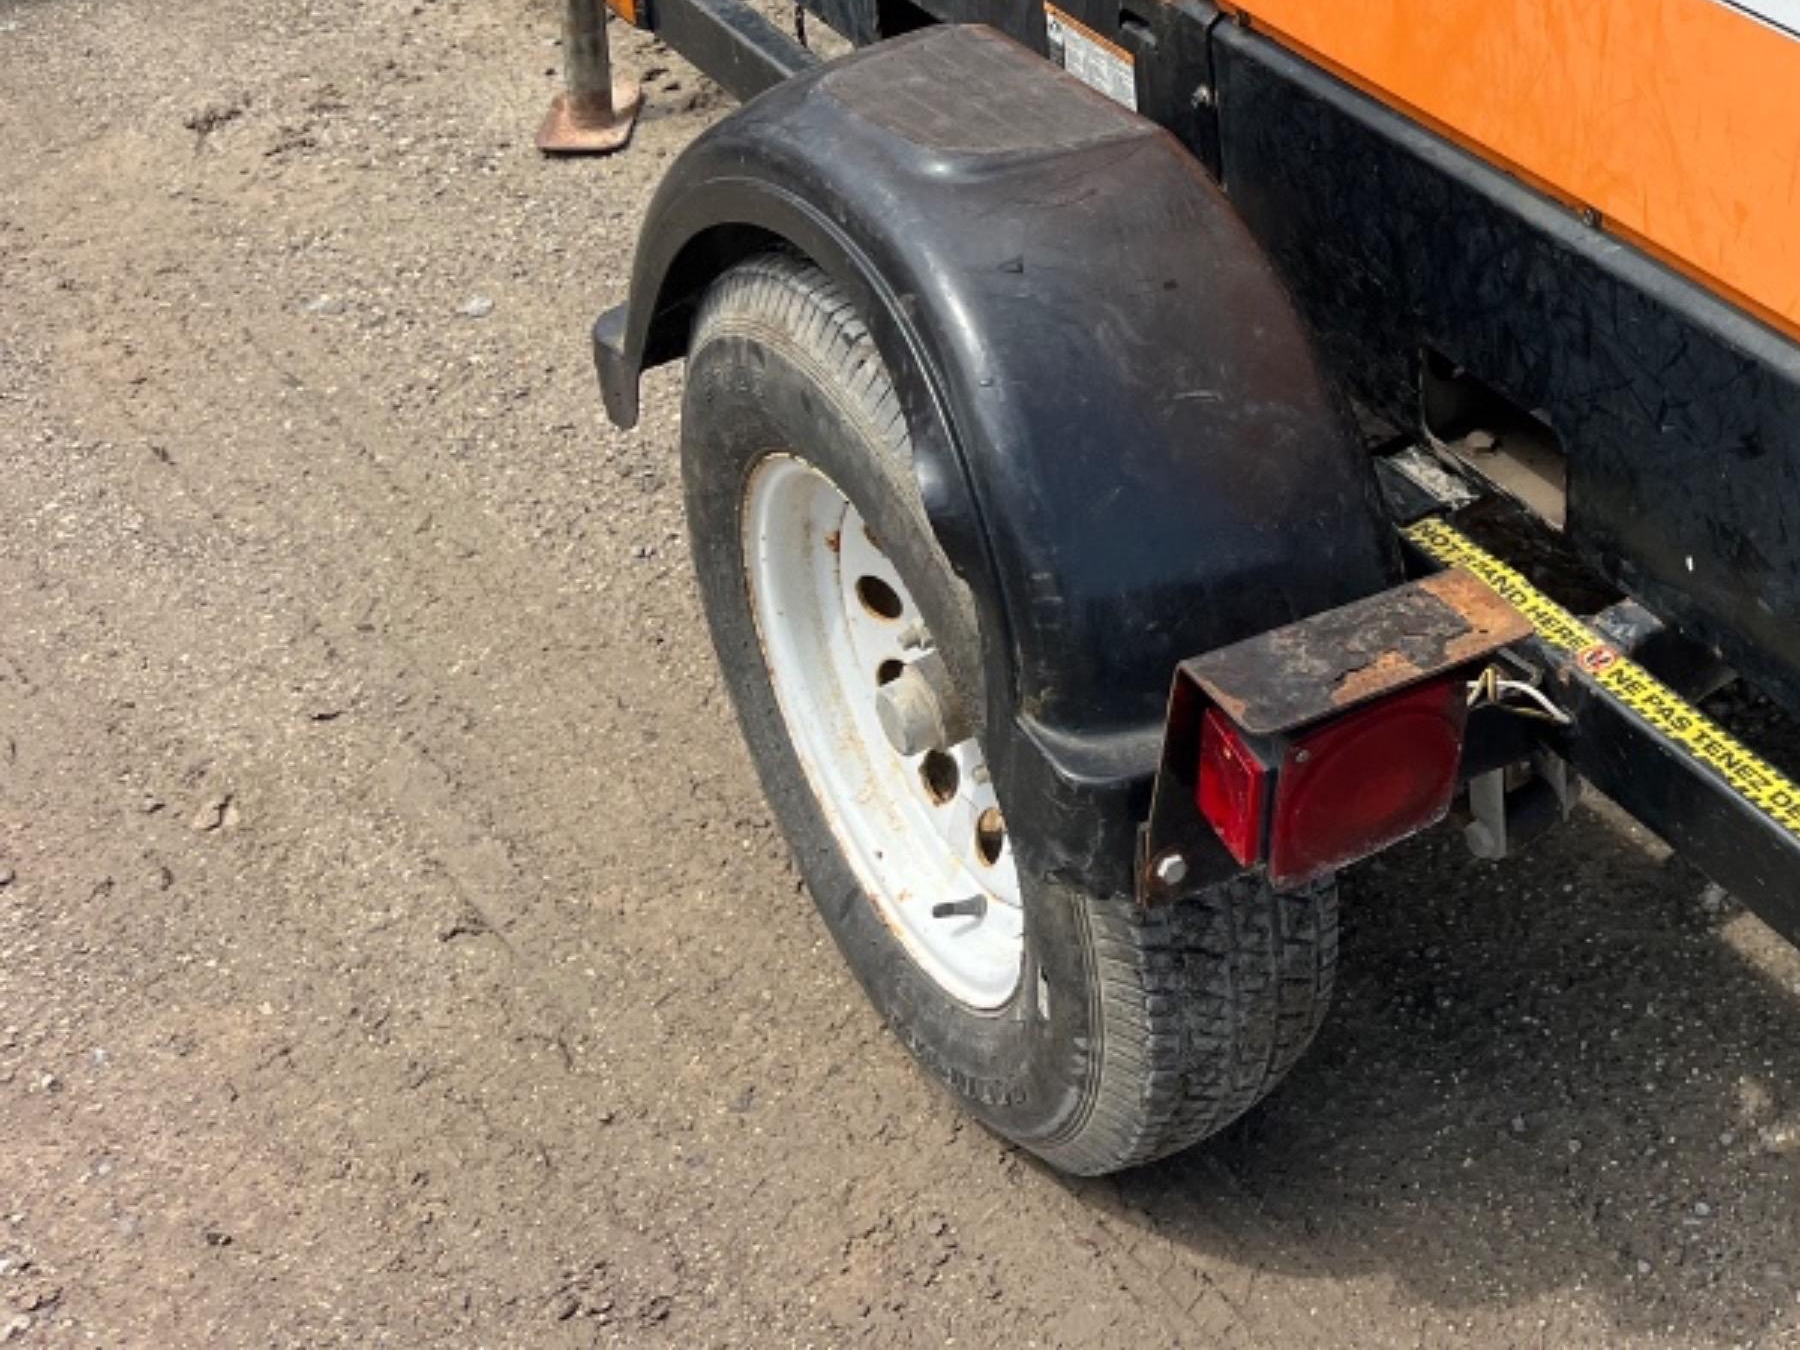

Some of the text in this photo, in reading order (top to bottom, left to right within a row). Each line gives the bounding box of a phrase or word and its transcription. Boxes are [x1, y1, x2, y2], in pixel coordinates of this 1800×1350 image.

[1525, 602, 1588, 649] HERE
[1608, 668, 1647, 696] NE
[1641, 693, 1693, 732] PAS
[1692, 729, 1774, 793] TENEZ
